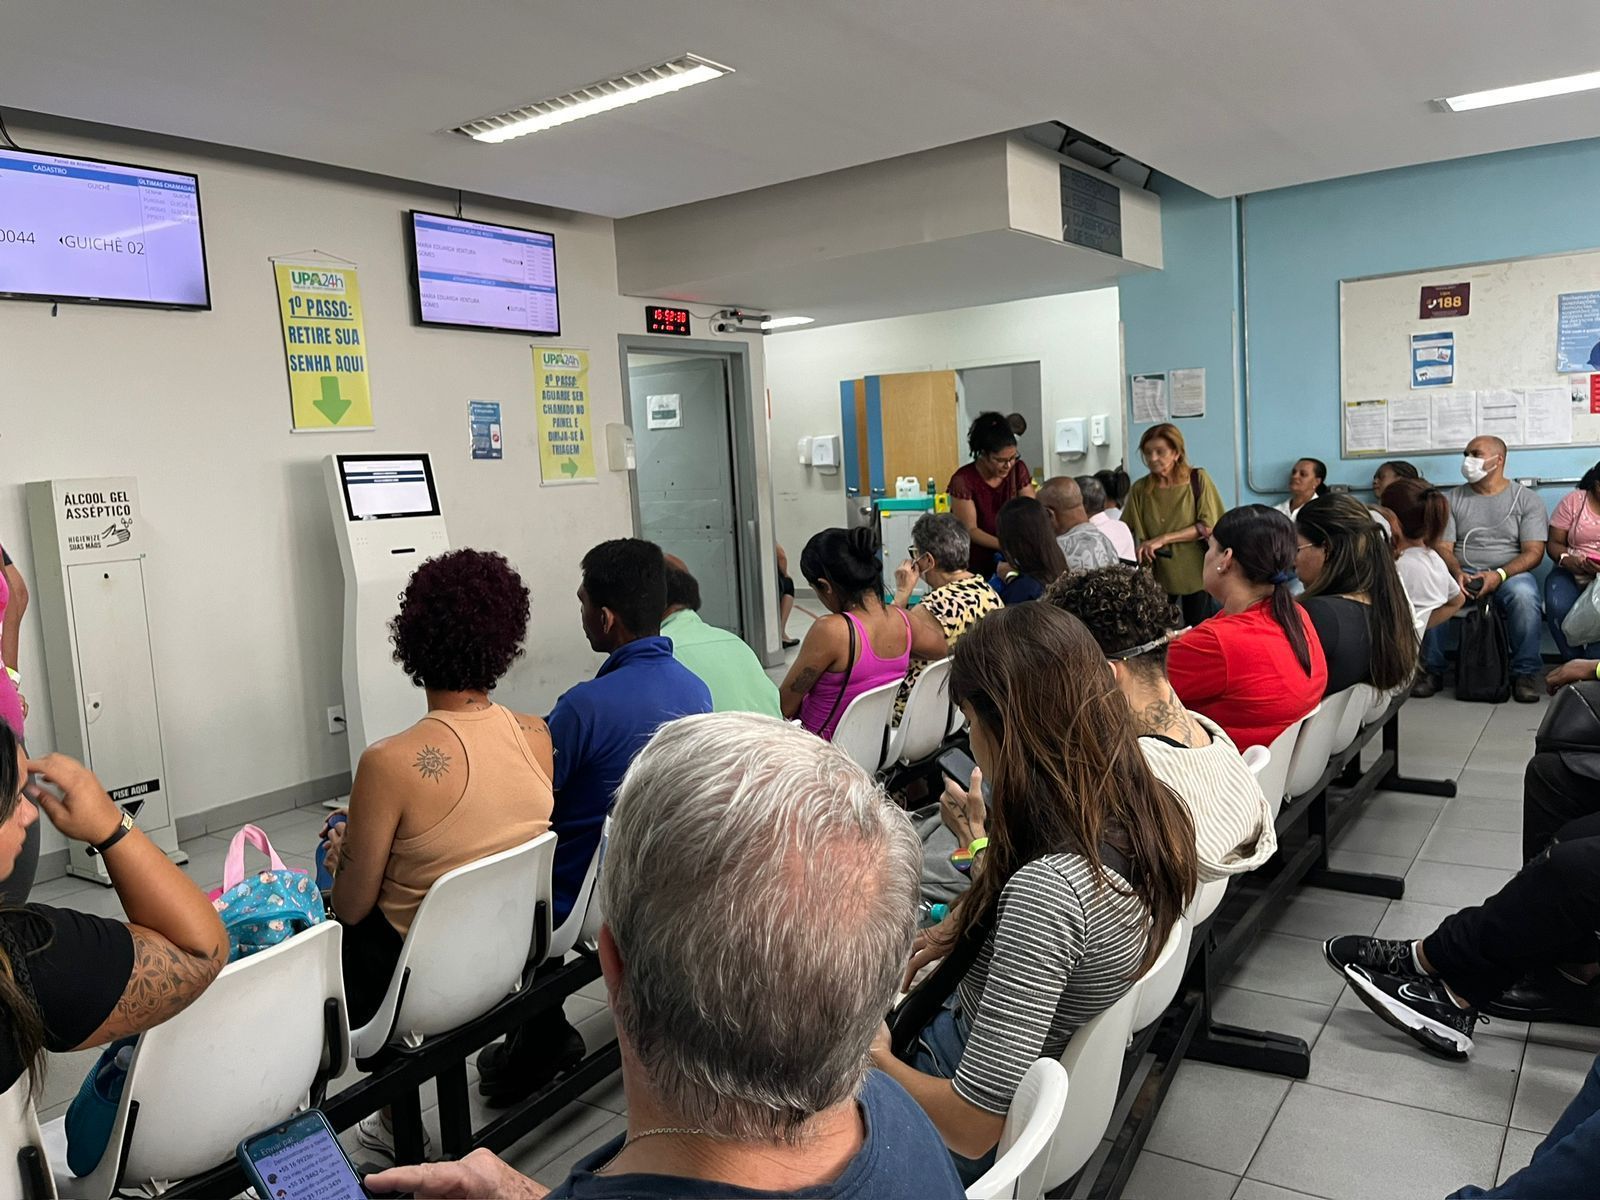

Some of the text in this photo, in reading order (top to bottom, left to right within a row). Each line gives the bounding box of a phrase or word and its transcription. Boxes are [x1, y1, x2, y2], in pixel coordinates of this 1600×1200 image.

[32, 163, 68, 175] CADASTRO
[64, 235, 145, 255] GUICHÊ 02
[291, 271, 344, 288] UPA24h
[306, 298, 353, 318] PASSO:
[1438, 296, 1462, 309] 188
[288, 325, 360, 345] RETIRE SUA
[289, 355, 364, 373] SENHA AQUI
[542, 390, 584, 401] AGUARDE SER
[543, 404, 585, 415] CHAMADO NO
[552, 417, 579, 428] PAINEL E
[548, 428, 585, 442] DIRIJA-SE À
[552, 444, 580, 455] TRIAGEM
[64, 491, 130, 506] ÁLCOOL GEL
[66, 504, 131, 519] ASSÉPTICO
[68, 534, 100, 543] HIGIENIZE
[69, 541, 101, 552] SUAS MÃOS
[113, 784, 148, 800] PISE AQUI
